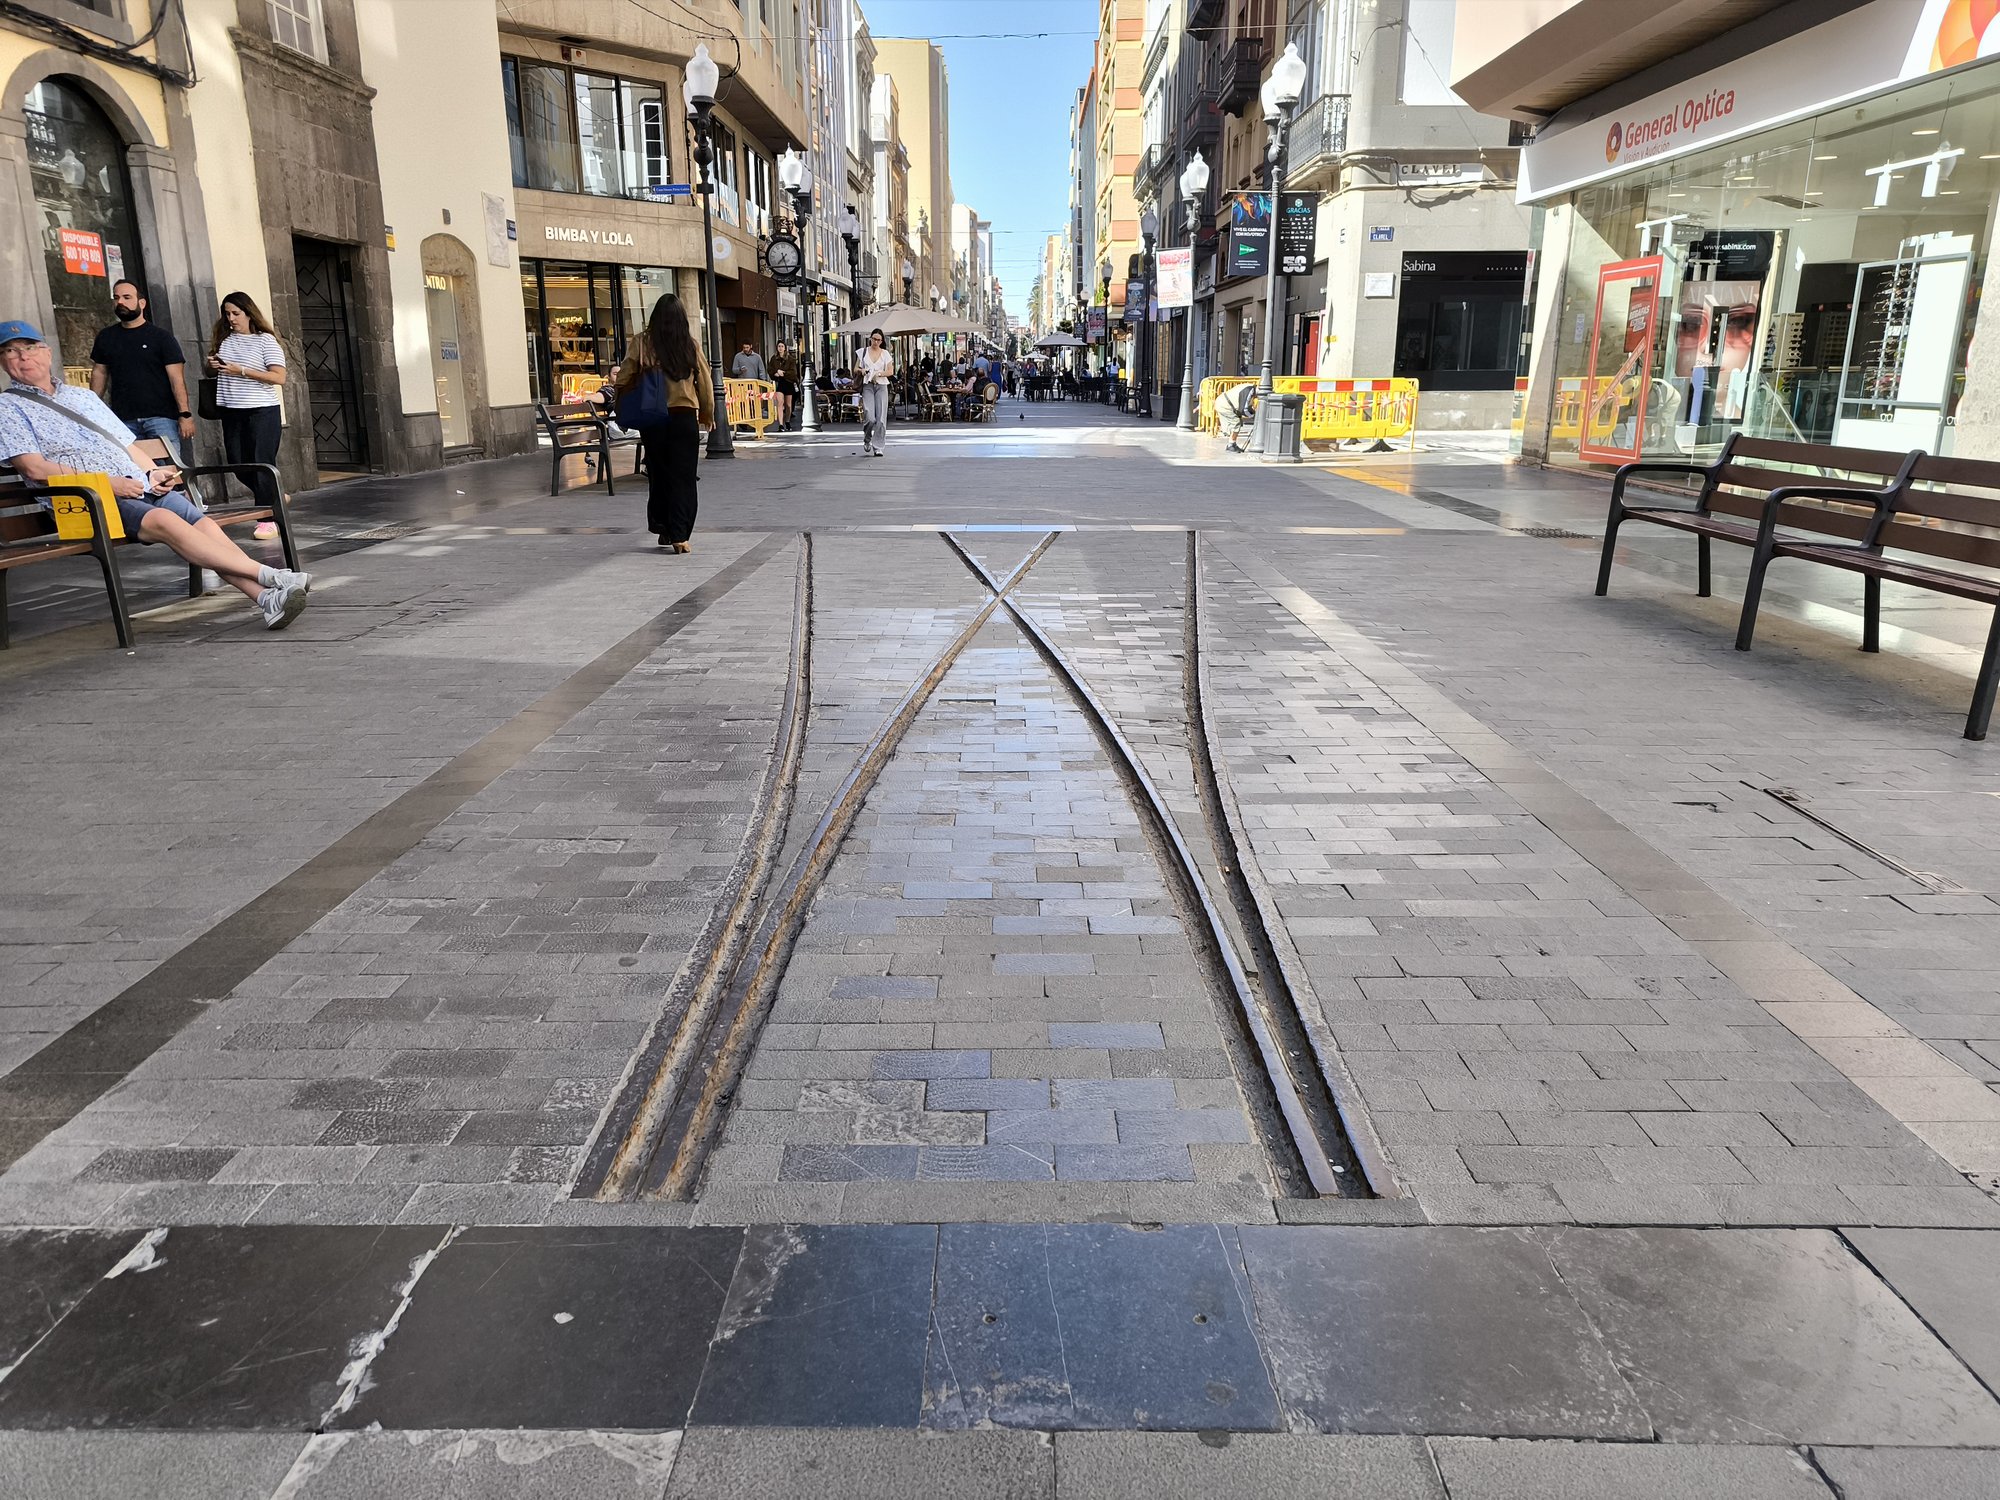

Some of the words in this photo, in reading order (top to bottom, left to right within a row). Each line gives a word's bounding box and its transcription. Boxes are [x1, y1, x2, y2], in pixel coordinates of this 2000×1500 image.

[1625, 105, 1679, 148] General
[1683, 89, 1735, 133] Optica
[1401, 164, 1459, 175] CLAVEL
[63, 231, 99, 247] DISPONIBLE
[545, 226, 589, 243] BIMBA
[590, 230, 599, 243] Y
[602, 231, 634, 246] LOLA
[1704, 241, 1757, 250] www.sabina.com
[1283, 256, 1307, 273] 50
[1403, 259, 1436, 272] Sabina
[424, 275, 446, 290] NTRO
[1686, 285, 1755, 304] ARMANI
